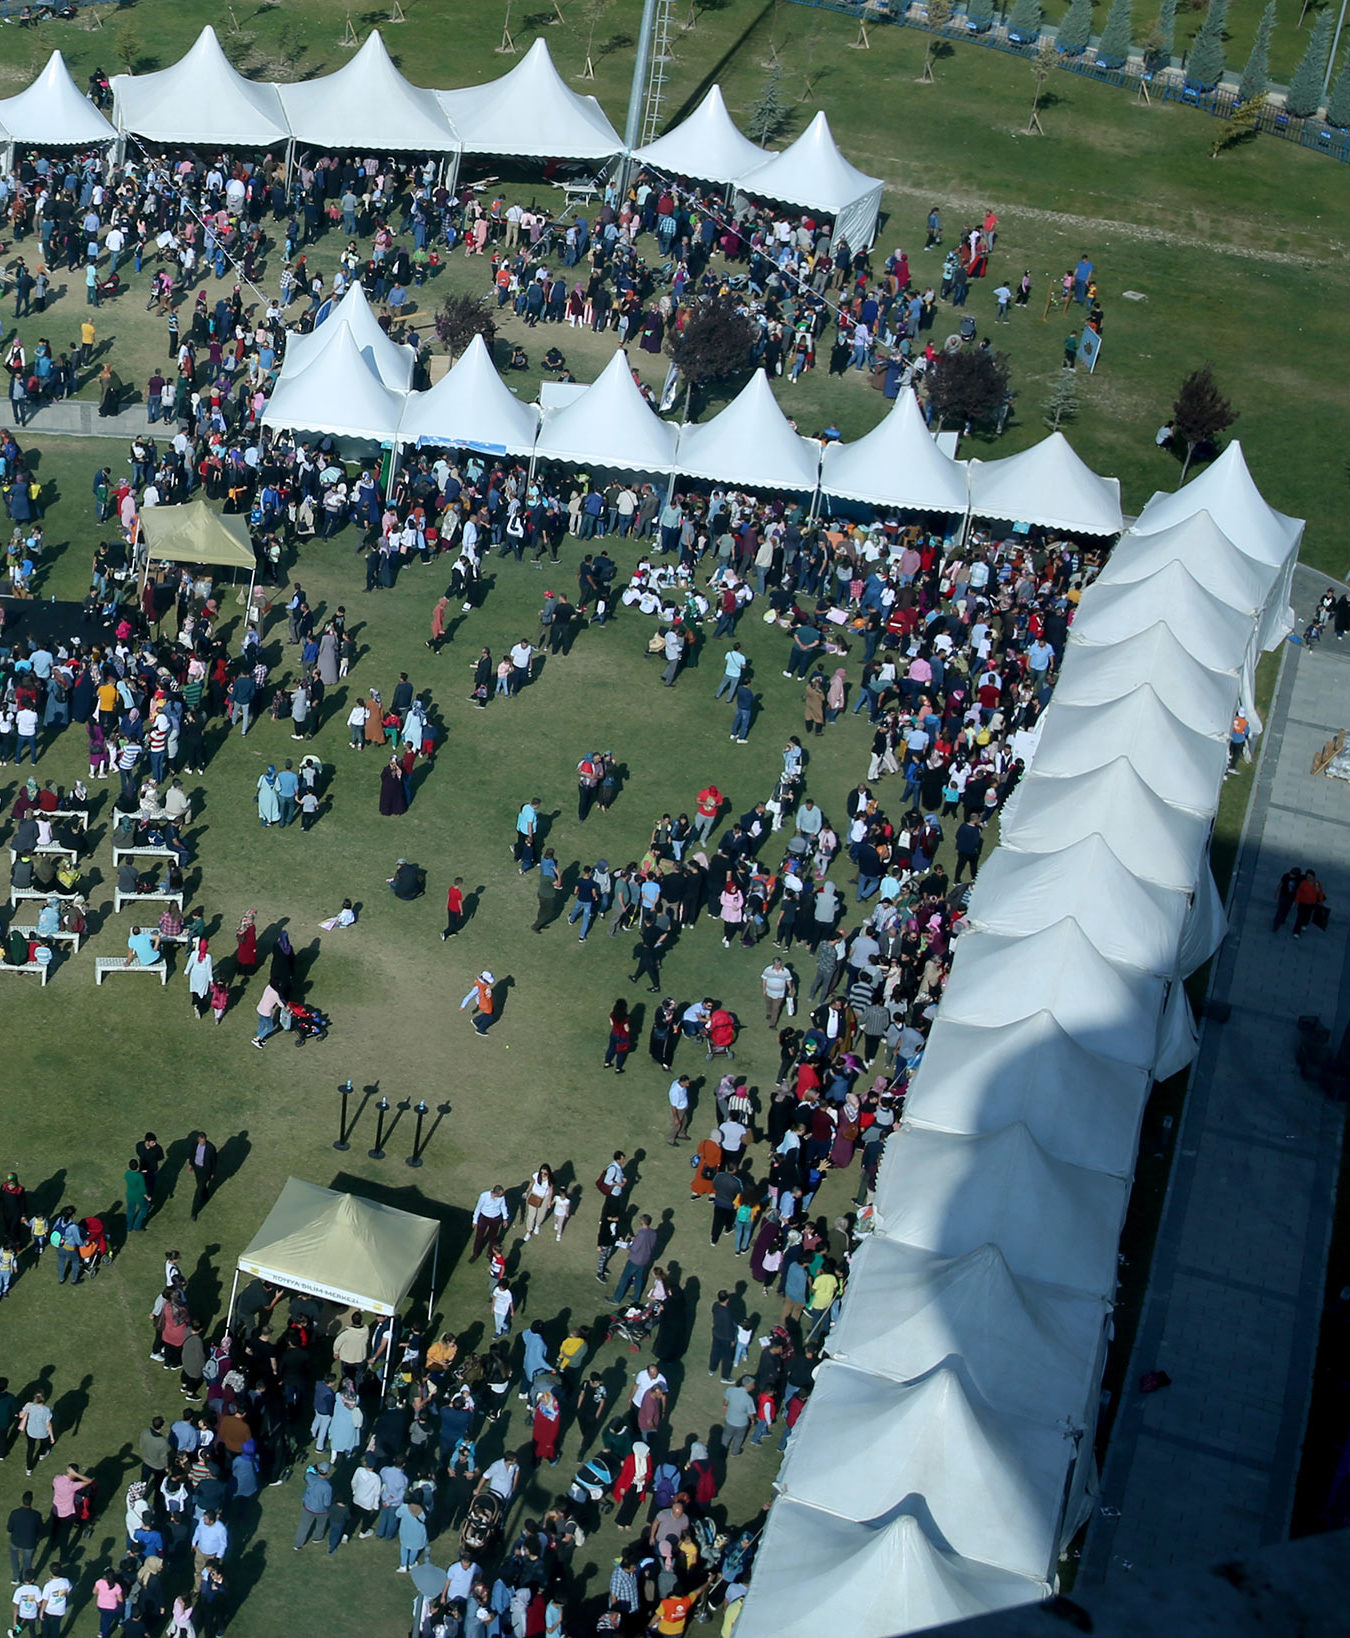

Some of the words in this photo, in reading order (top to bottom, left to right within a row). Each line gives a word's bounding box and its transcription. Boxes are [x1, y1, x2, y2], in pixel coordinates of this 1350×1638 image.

[272, 1274, 300, 1287] KONYA
[301, 1282, 324, 1295] BİLİM
[324, 1290, 359, 1304] MERKEZİ
